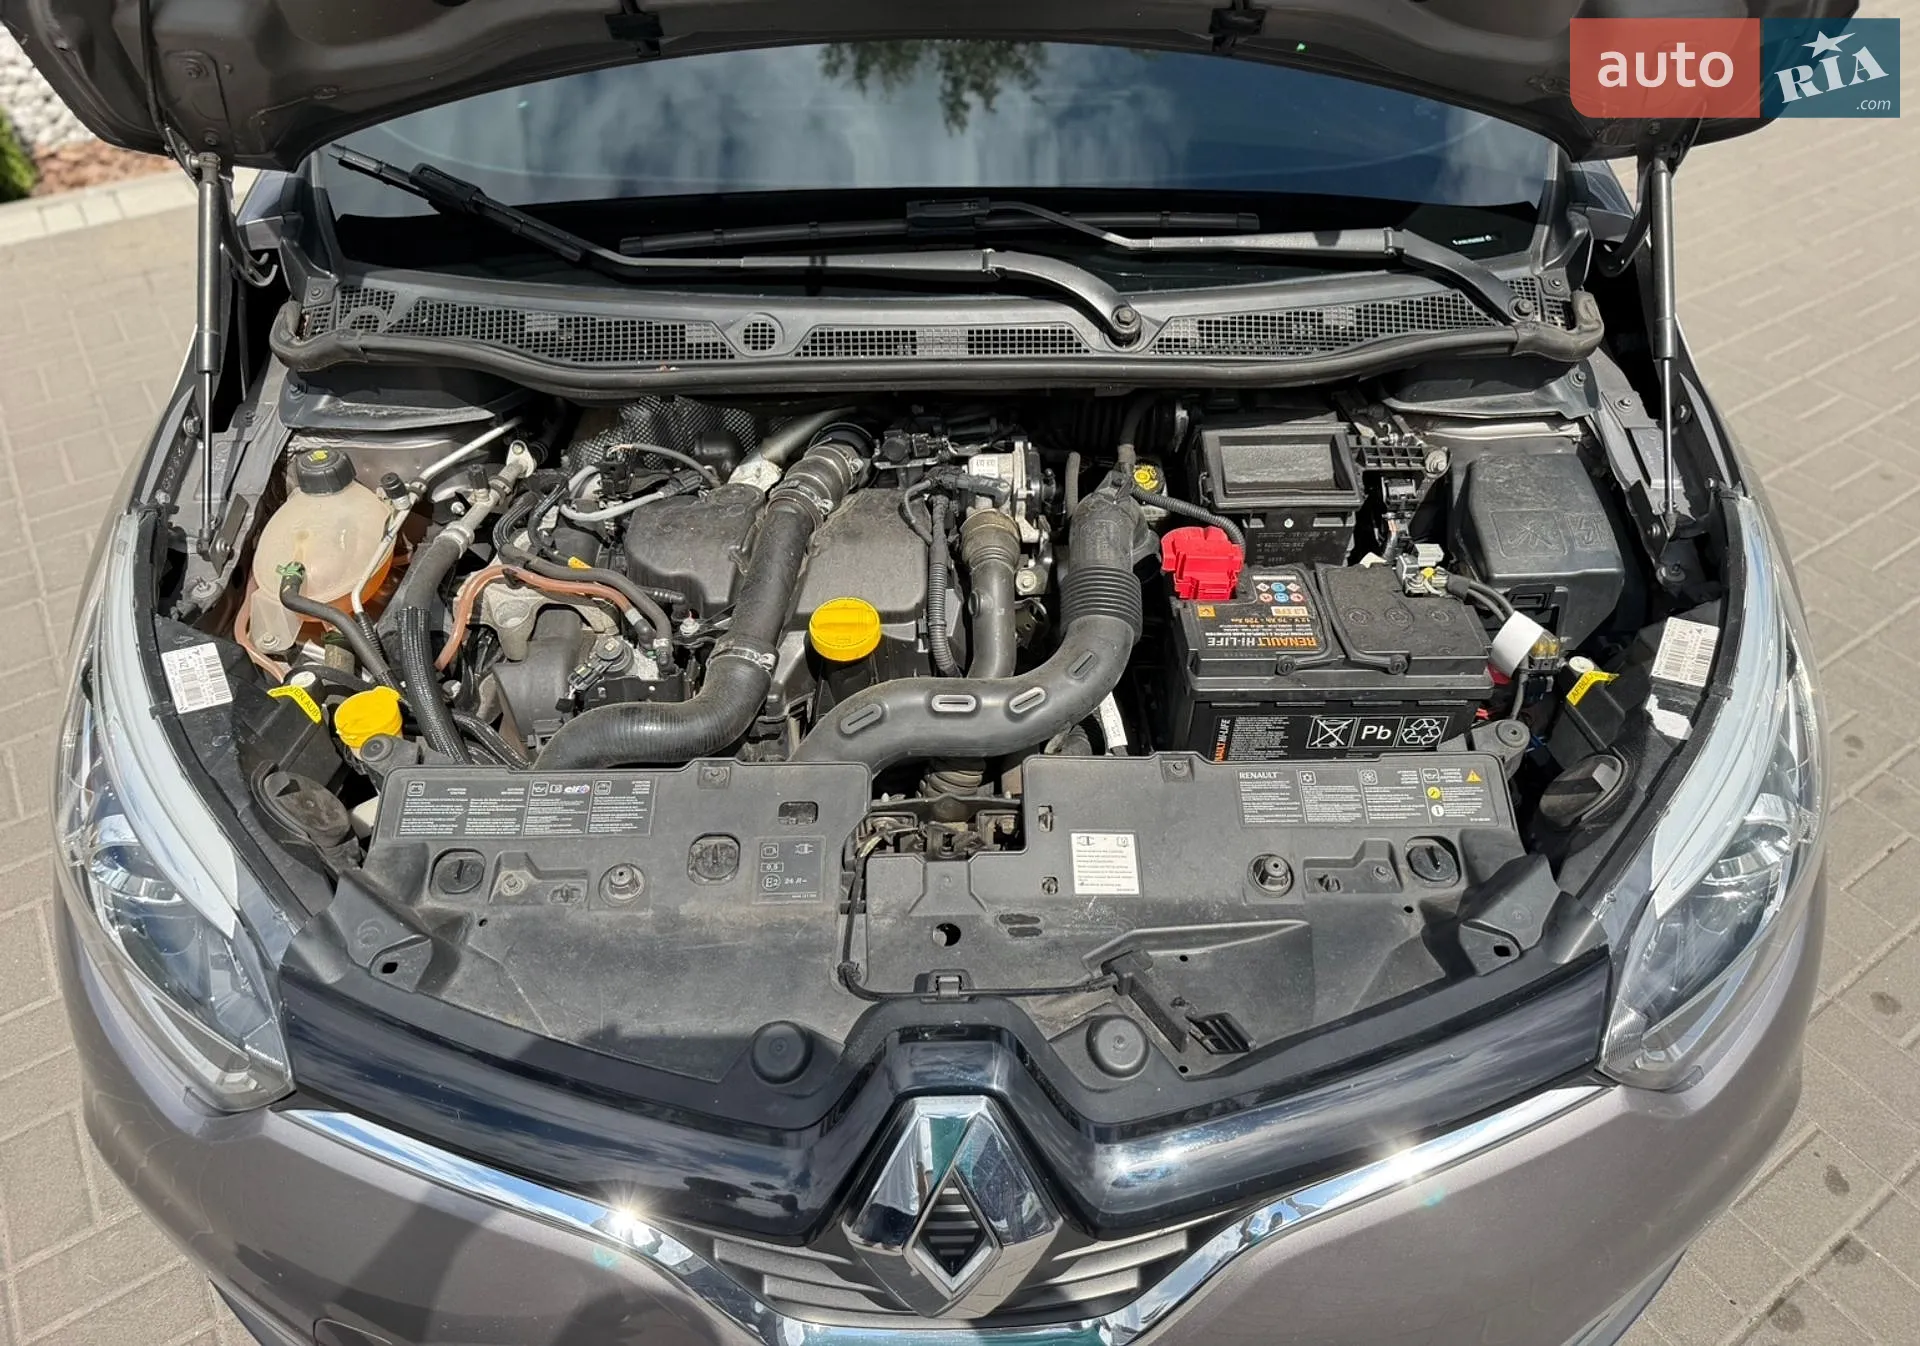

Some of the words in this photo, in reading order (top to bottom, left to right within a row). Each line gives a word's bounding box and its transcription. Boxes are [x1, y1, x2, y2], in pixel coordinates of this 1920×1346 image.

[1257, 637, 1317, 646] RENAULT
[1361, 724, 1392, 740] Pb
[1239, 771, 1278, 779] RENAULT
